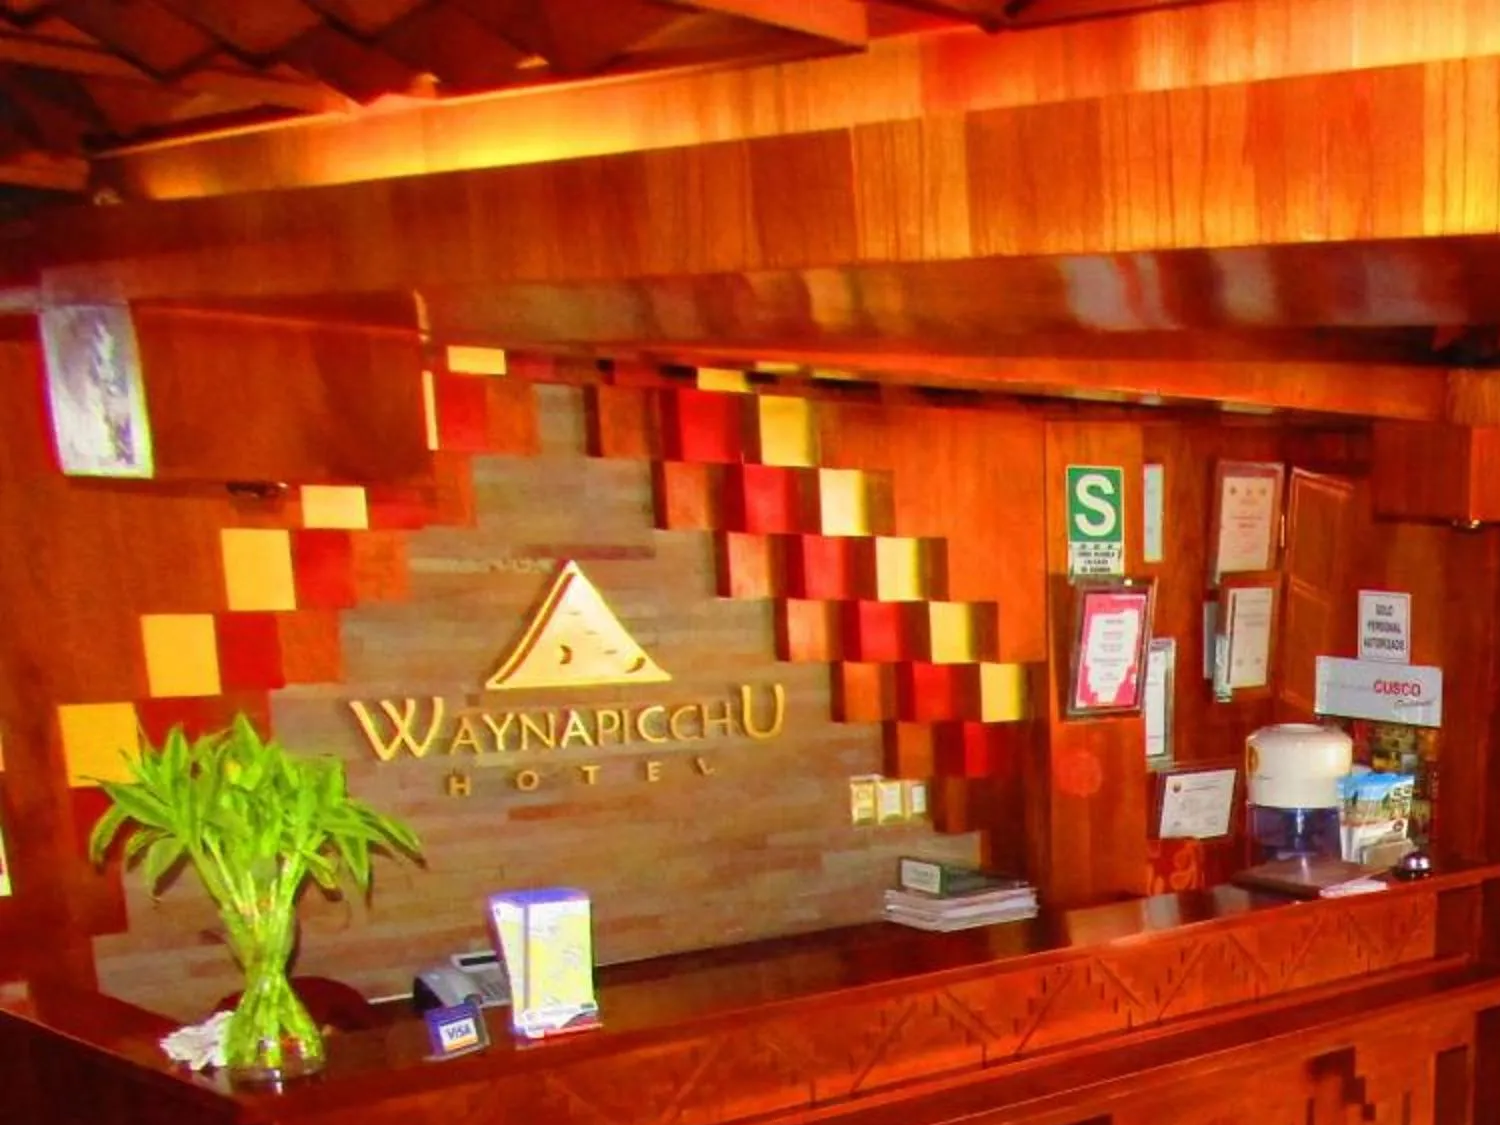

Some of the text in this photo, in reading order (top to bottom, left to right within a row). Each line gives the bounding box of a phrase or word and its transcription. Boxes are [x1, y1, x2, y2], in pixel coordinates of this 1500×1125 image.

[1075, 474, 1116, 537] S
[1373, 678, 1421, 697] CUSCO
[448, 757, 716, 797] HOTEL
[445, 1023, 471, 1042] VISA
